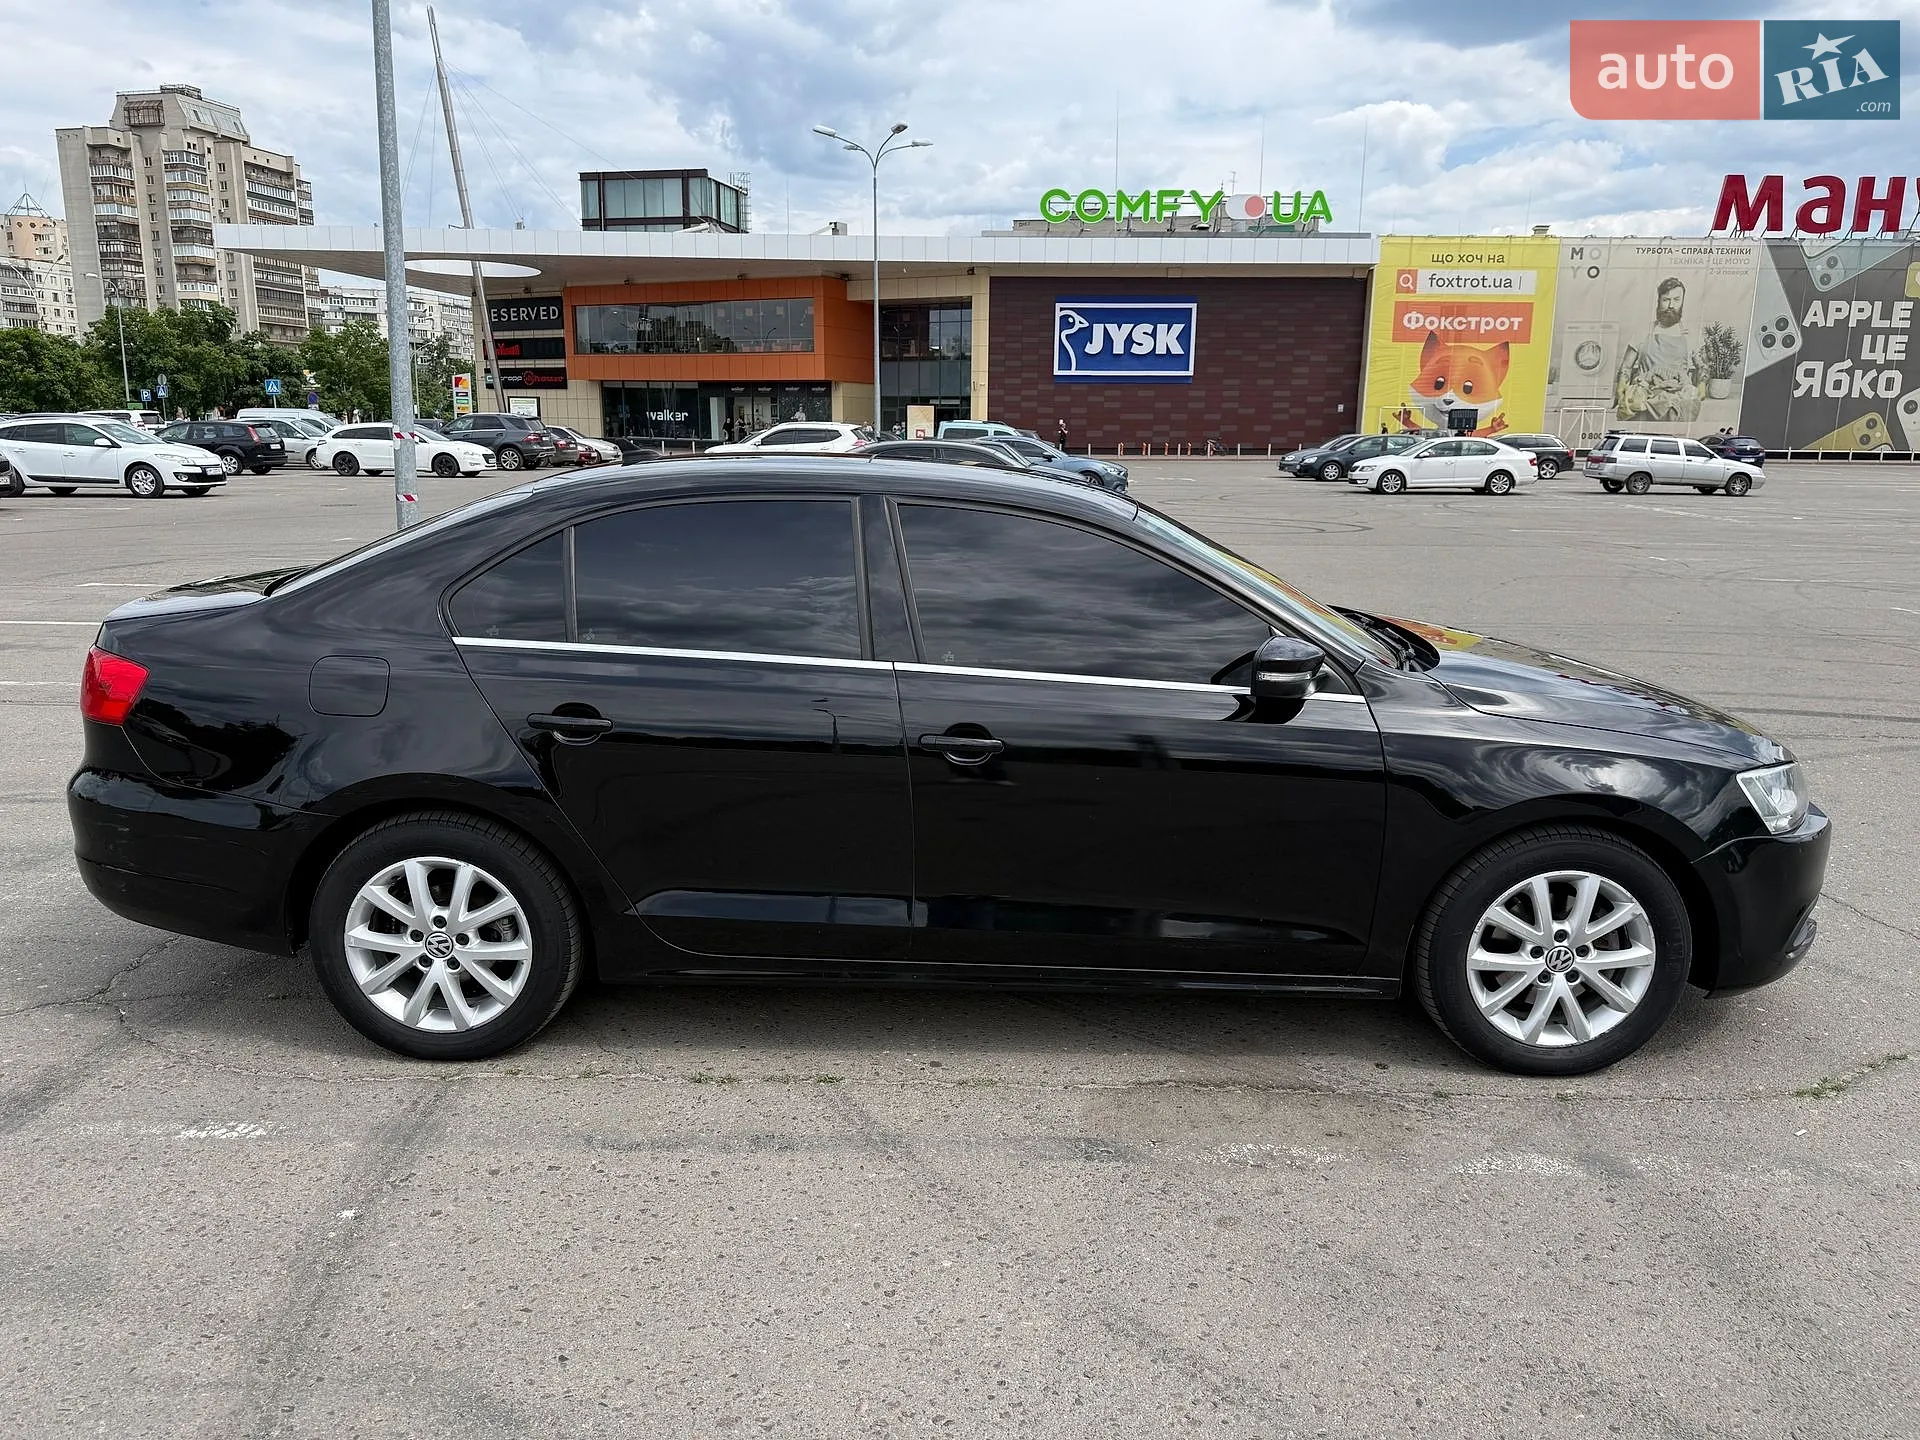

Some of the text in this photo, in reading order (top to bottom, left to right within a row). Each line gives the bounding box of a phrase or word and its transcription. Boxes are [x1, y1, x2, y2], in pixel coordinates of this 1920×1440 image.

[1039, 188, 1334, 224] COMFY UA
[1712, 174, 1920, 234] ман
[1431, 253, 1505, 264] що хоч на
[1636, 247, 1673, 255] ТУРБОТА
[1681, 247, 1713, 255] СПРАВА
[1715, 247, 1752, 255] ТЕХНІКИ
[1428, 273, 1513, 289] foxtrot.ua
[491, 306, 559, 321] ESERVED
[1402, 311, 1524, 334] Фокстрот
[1802, 300, 1913, 328] APPLE
[1084, 323, 1186, 355] JYSK
[1861, 334, 1909, 364] ЦЕ
[1792, 358, 1903, 399] Ябко
[646, 409, 688, 422] walker
